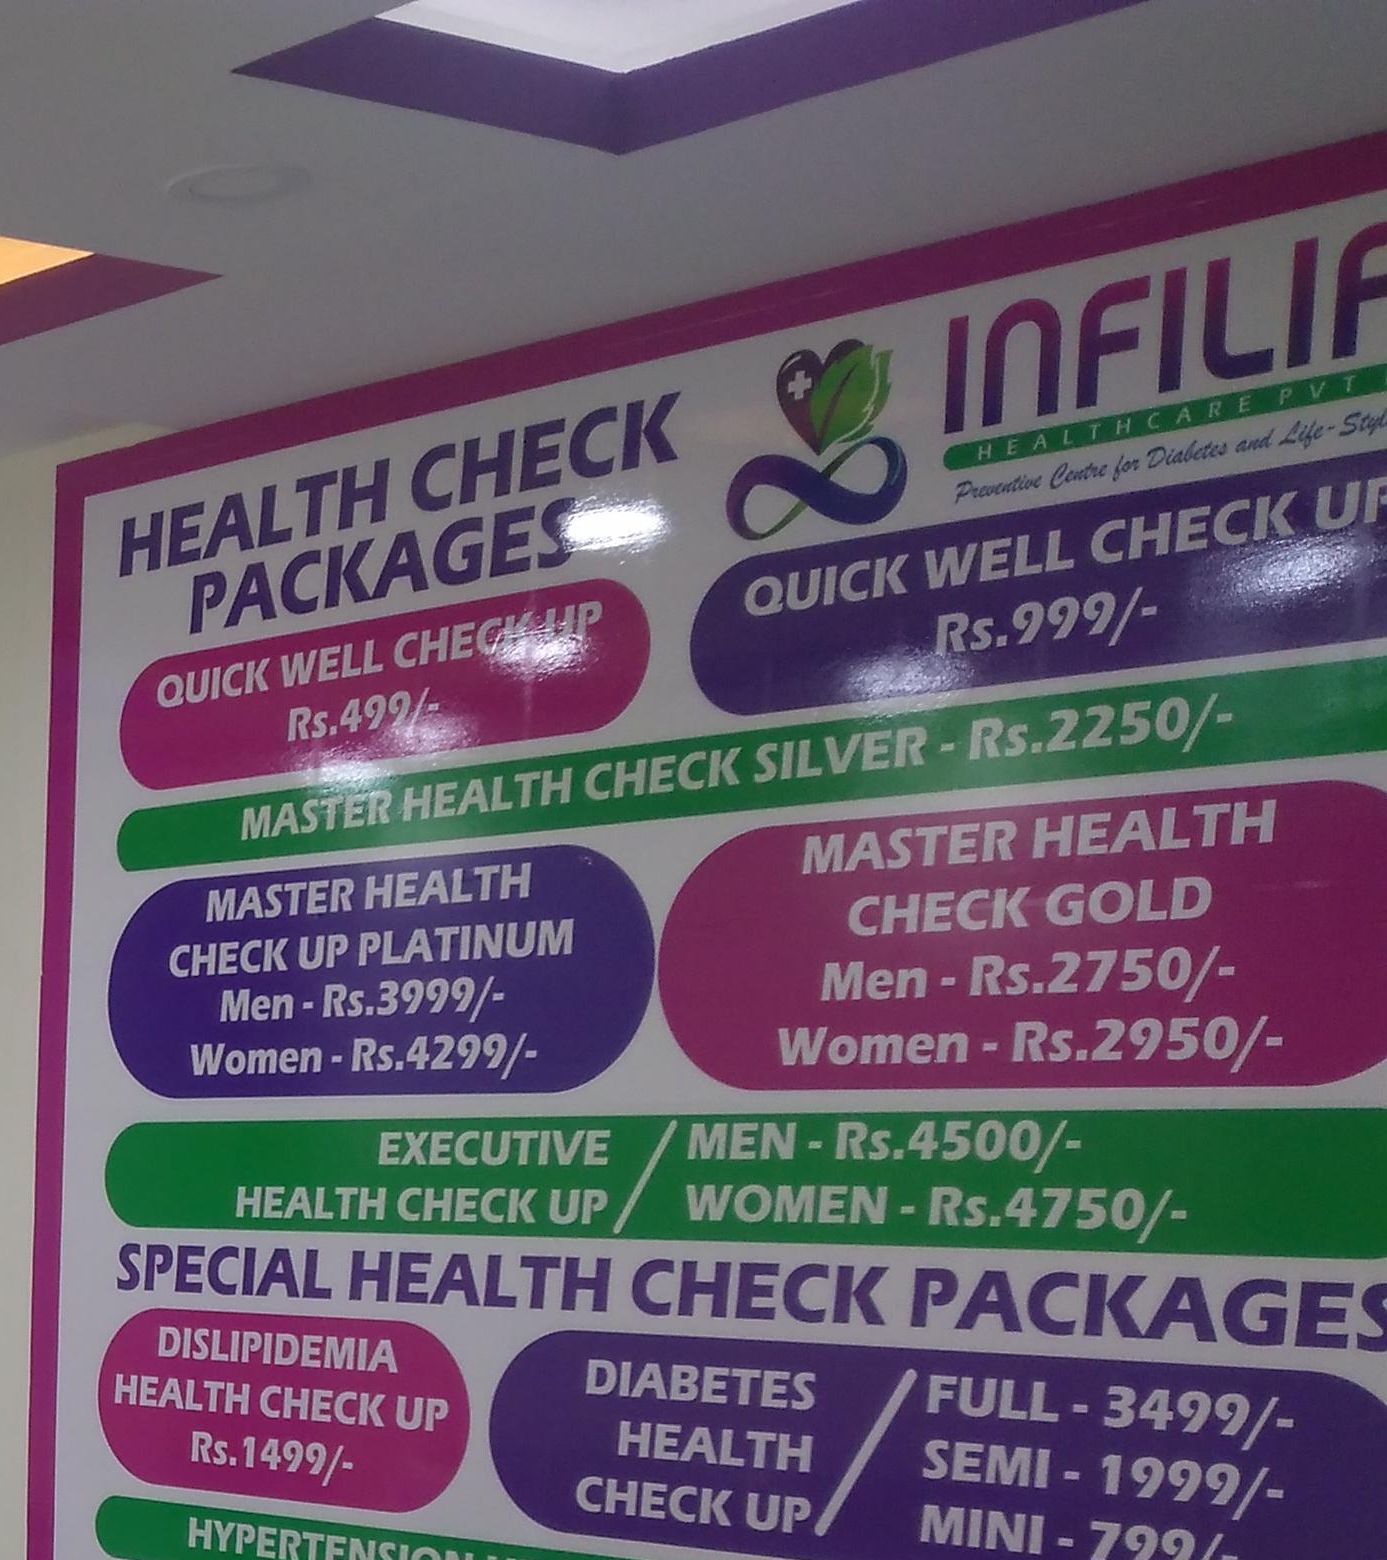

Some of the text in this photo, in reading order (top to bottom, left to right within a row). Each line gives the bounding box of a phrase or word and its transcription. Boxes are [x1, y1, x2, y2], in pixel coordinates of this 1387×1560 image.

[977, 374, 1356, 461] HEALTHCARE PVT
[119, 392, 681, 576] HEALTH CHECK
[954, 468, 1043, 505] Preventive
[1048, 458, 1110, 493] Centre
[1113, 450, 1141, 485] for
[1145, 438, 1229, 474] Diabetes
[1234, 428, 1274, 455] and
[189, 498, 575, 634] PACKAGES
[743, 552, 909, 619] QUICK
[925, 534, 1076, 591] WELL
[1089, 489, 1299, 566] CHECK
[934, 585, 1158, 656] Rs.999/-
[157, 600, 603, 708] QUICK WELL CHECK UP
[287, 688, 439, 742] Rs.499/-
[241, 693, 1233, 840] MASTER HEALTH CHECK SILVER Rs.2250/-
[800, 799, 1277, 876] MASTER HEALTH
[205, 861, 531, 923] MASTER HEALTH
[847, 876, 1213, 938] CHECK GOLD
[168, 918, 574, 979] CHECK UP PLATINUM
[820, 945, 1235, 1003] Men Rs.2750/-
[220, 976, 505, 1024] Men Rs.3999/-
[190, 1032, 537, 1080] Women Rs.4299/-
[777, 1015, 1283, 1073] Women Rs.2950/-
[377, 1129, 611, 1167] EXECUTIVE
[687, 1119, 1081, 1174] MEN Rs.4500/-
[234, 1185, 608, 1226] HEALTH CHECK UP
[687, 1183, 1187, 1244] WOMEN Rs.4750/-
[116, 1242, 332, 1299] SPECIAL
[348, 1249, 611, 1312] HEALTH
[631, 1256, 889, 1327] CHECK
[157, 1325, 399, 1374] DISLIPIDEMIA
[114, 1373, 450, 1433] HEALTH CHECK UP
[585, 1358, 816, 1410] DIABETES
[926, 1374, 1294, 1451] FULL 3499/-
[190, 1430, 353, 1487] Rs.1499/-
[617, 1420, 813, 1474] HEALTH
[575, 1476, 812, 1535] CHECK UP
[922, 1439, 1284, 1521] SEMI 1999/-
[920, 1503, 1046, 1555] MINI
